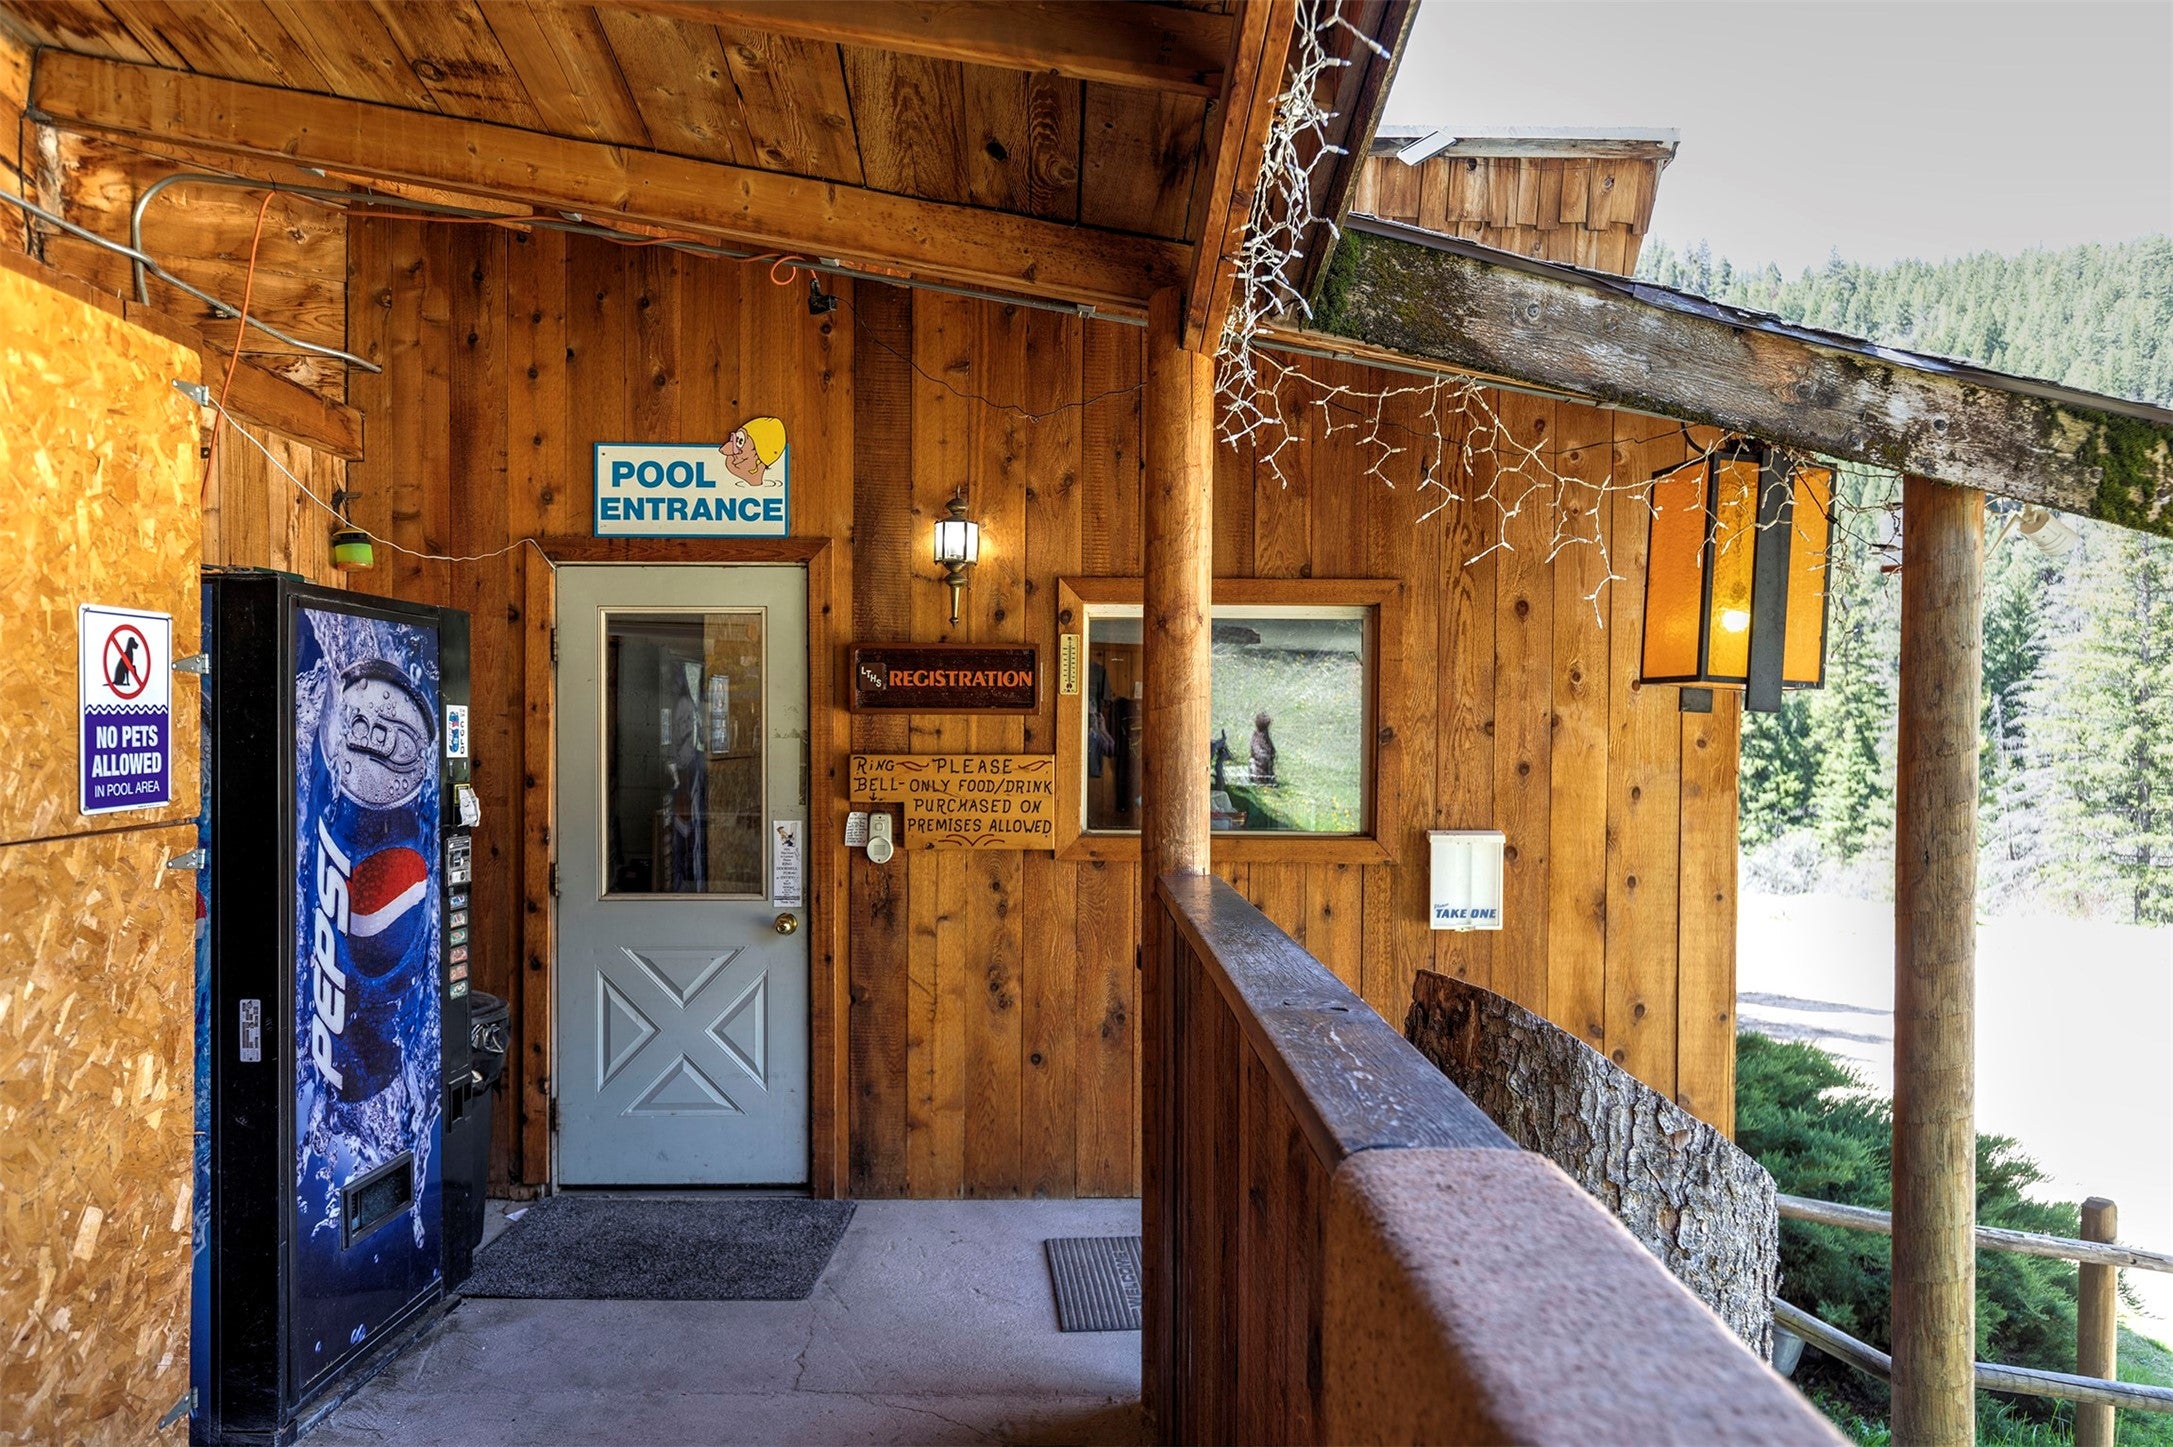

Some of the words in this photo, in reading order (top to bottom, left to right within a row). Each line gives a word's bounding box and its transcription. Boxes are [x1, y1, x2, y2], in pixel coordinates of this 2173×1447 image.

[612, 461, 716, 488] POOL
[600, 497, 783, 521] ENTRANCE
[861, 666, 882, 687] LTHS
[889, 670, 1033, 687] REGISTRATION
[96, 725, 118, 749] NO
[122, 725, 158, 748] PETS
[91, 752, 162, 778] ALLOWED
[932, 758, 1012, 774] PLEASE
[94, 784, 105, 798] IN
[107, 782, 134, 797] POOL
[135, 780, 160, 794] AREA
[909, 779, 950, 792] ONLY
[959, 778, 1052, 795] FOOD/DRINK
[913, 798, 1011, 815] PURCHASED
[1020, 800, 1042, 813] ON
[907, 818, 982, 833] PREMISES
[988, 819, 1052, 834] ALLOWED
[1436, 909, 1467, 918] TAKE
[1470, 909, 1497, 918] ONE
[311, 815, 350, 1090] PEPSI
